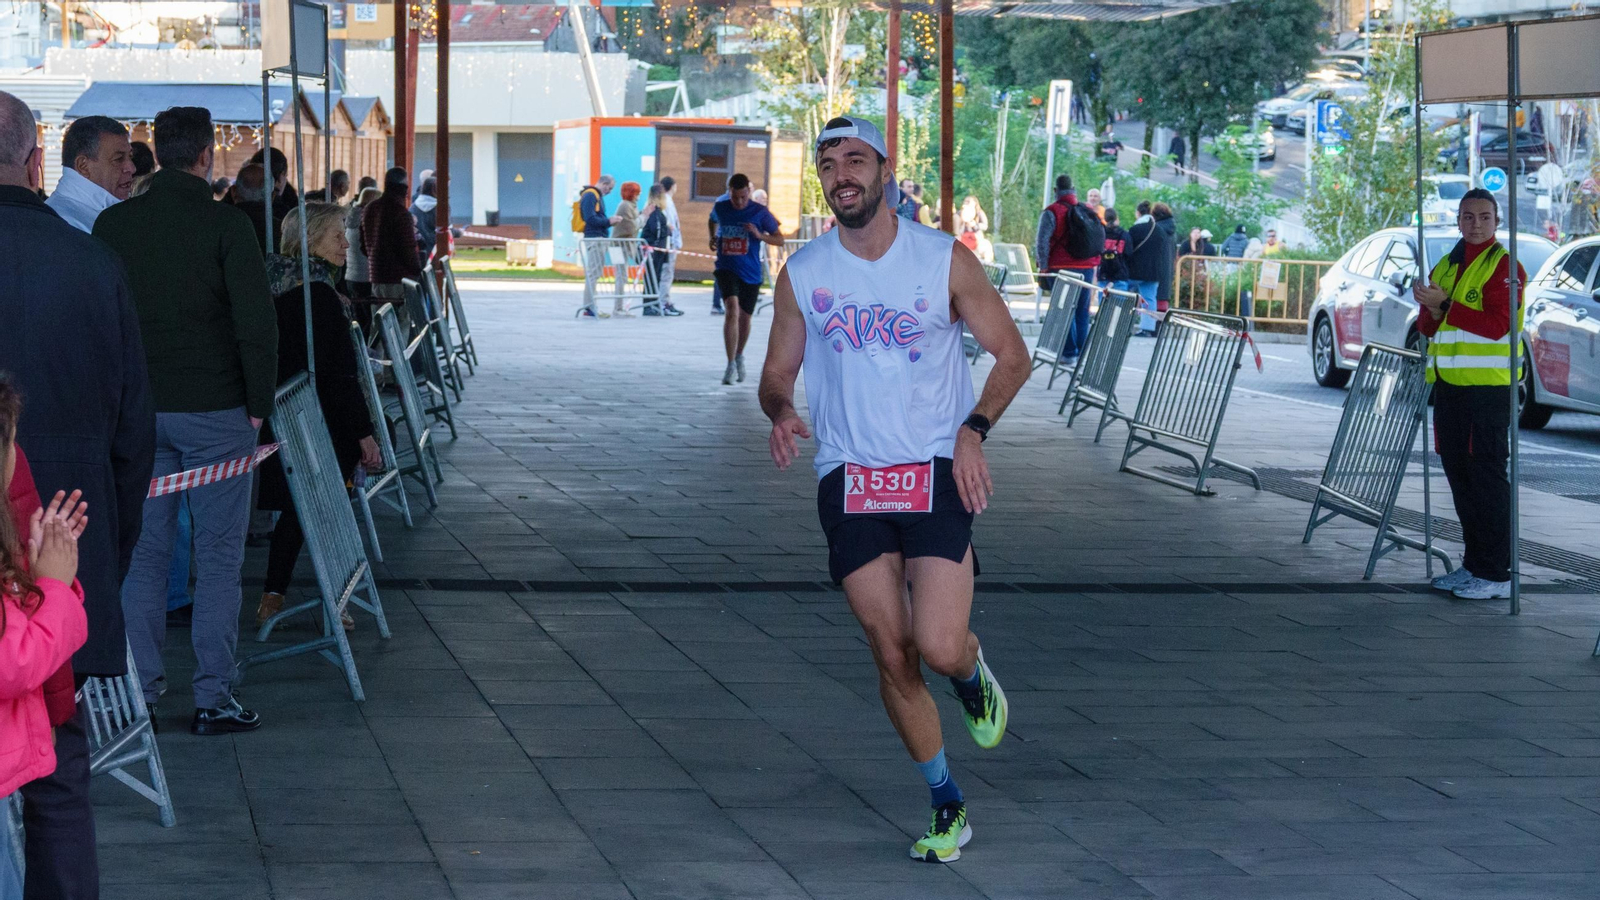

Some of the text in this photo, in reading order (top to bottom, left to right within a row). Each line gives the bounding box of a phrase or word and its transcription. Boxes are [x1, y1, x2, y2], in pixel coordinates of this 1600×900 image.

[823, 303, 925, 350] NIKE
[870, 471, 916, 491] 530
[863, 498, 912, 511] Alcampo
